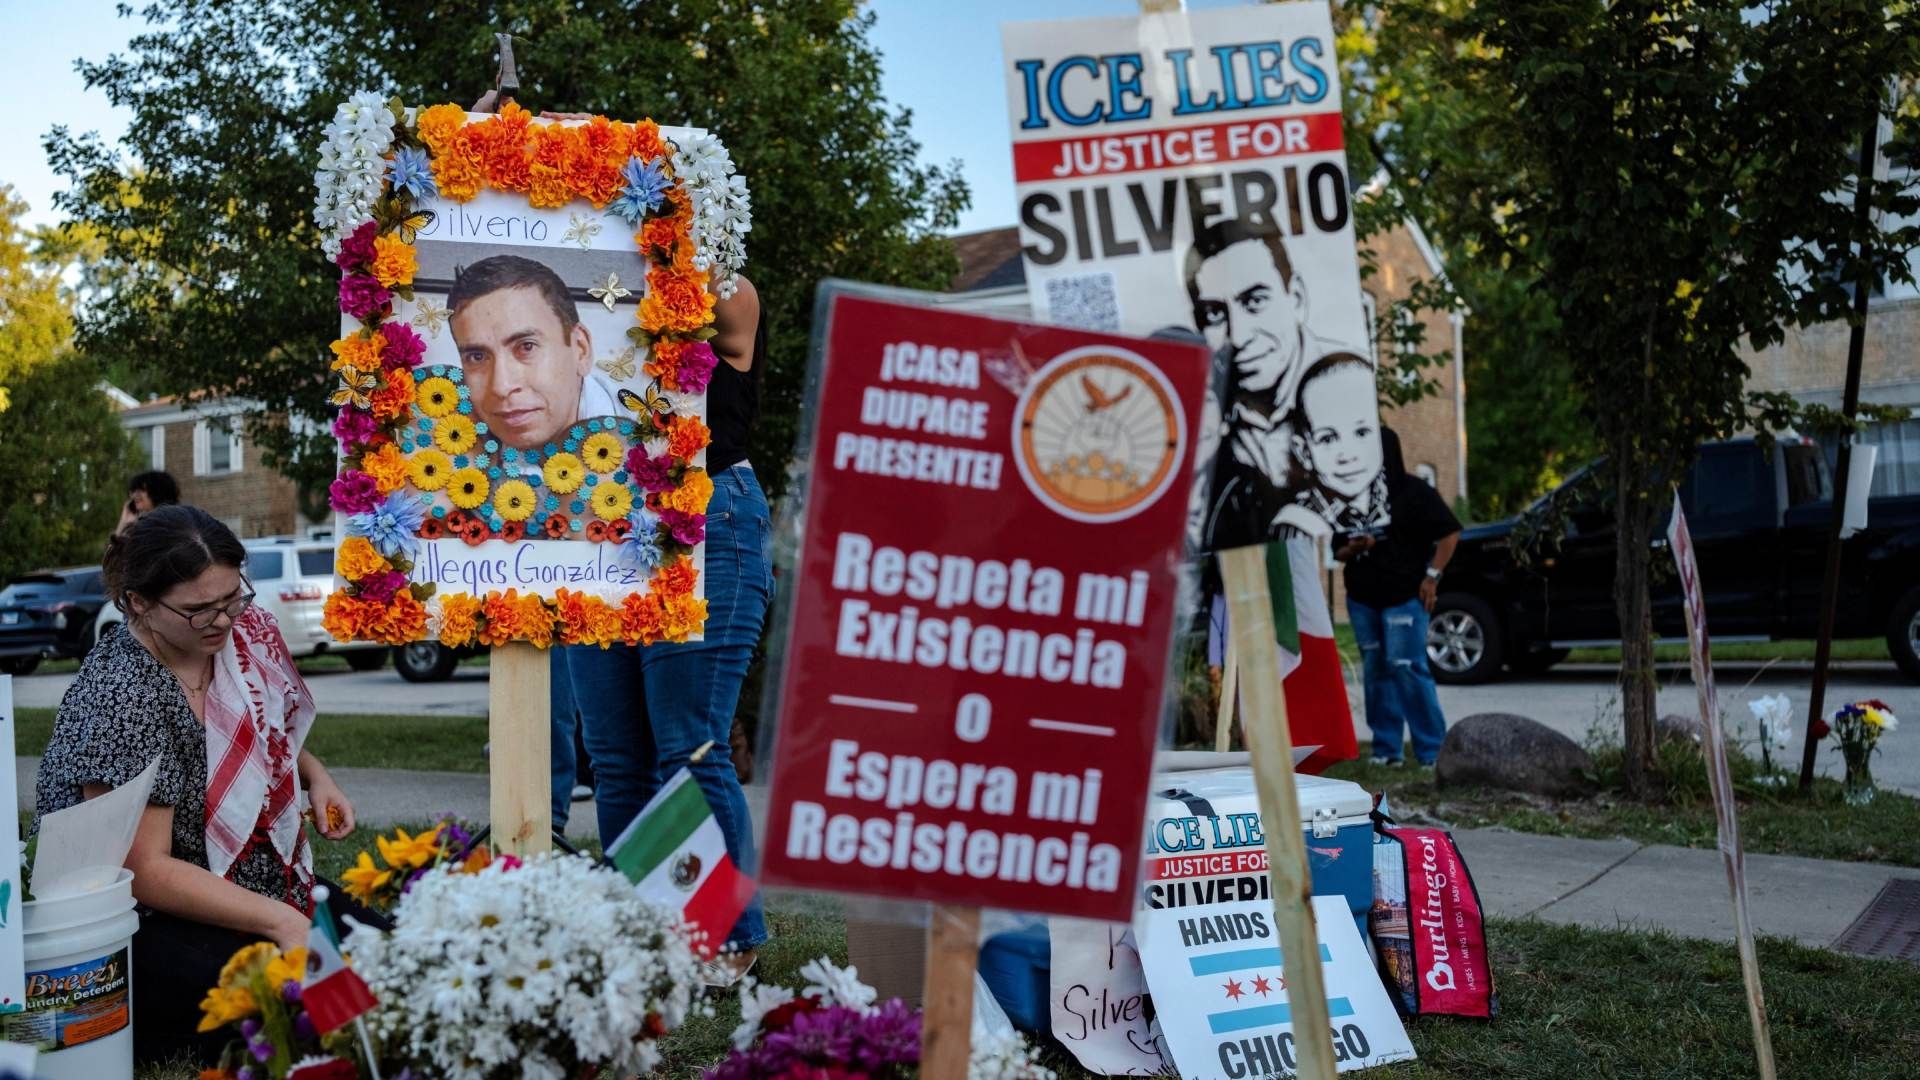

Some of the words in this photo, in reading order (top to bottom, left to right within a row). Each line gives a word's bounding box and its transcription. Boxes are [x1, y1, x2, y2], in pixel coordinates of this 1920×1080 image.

[1015, 53, 1153, 130] ICE
[1164, 36, 1329, 116] LIES
[1052, 128, 1217, 177] JUSTICE
[1228, 119, 1309, 158] FOR
[1020, 161, 1349, 266] SILVERIO
[880, 341, 981, 390] ¡CASA
[860, 386, 990, 440] DUPAGE
[834, 431, 1003, 491] PRESENTE!
[831, 531, 1065, 617] Respeta
[1073, 570, 1150, 627] mi
[835, 598, 1127, 689] Existencia
[825, 739, 1017, 816] Espera
[1027, 768, 1102, 825] mi
[786, 800, 1121, 892] Resistencia
[1146, 816, 1205, 854] ICE
[1207, 812, 1266, 849] LIE
[1144, 874, 1273, 911] SILVERI
[1160, 855, 1233, 878] JUSTICE
[1236, 852, 1272, 871] FOR
[1450, 885, 1461, 903] BABY
[1455, 911, 1465, 929] KIDS
[1177, 911, 1271, 948] HANDS
[26, 961, 119, 997] Breezy
[27, 995, 70, 1009] undry
[73, 976, 125, 1001] Detergent
[1063, 983, 1142, 1041] Silve
[1218, 1023, 1371, 1079] CHICGO
